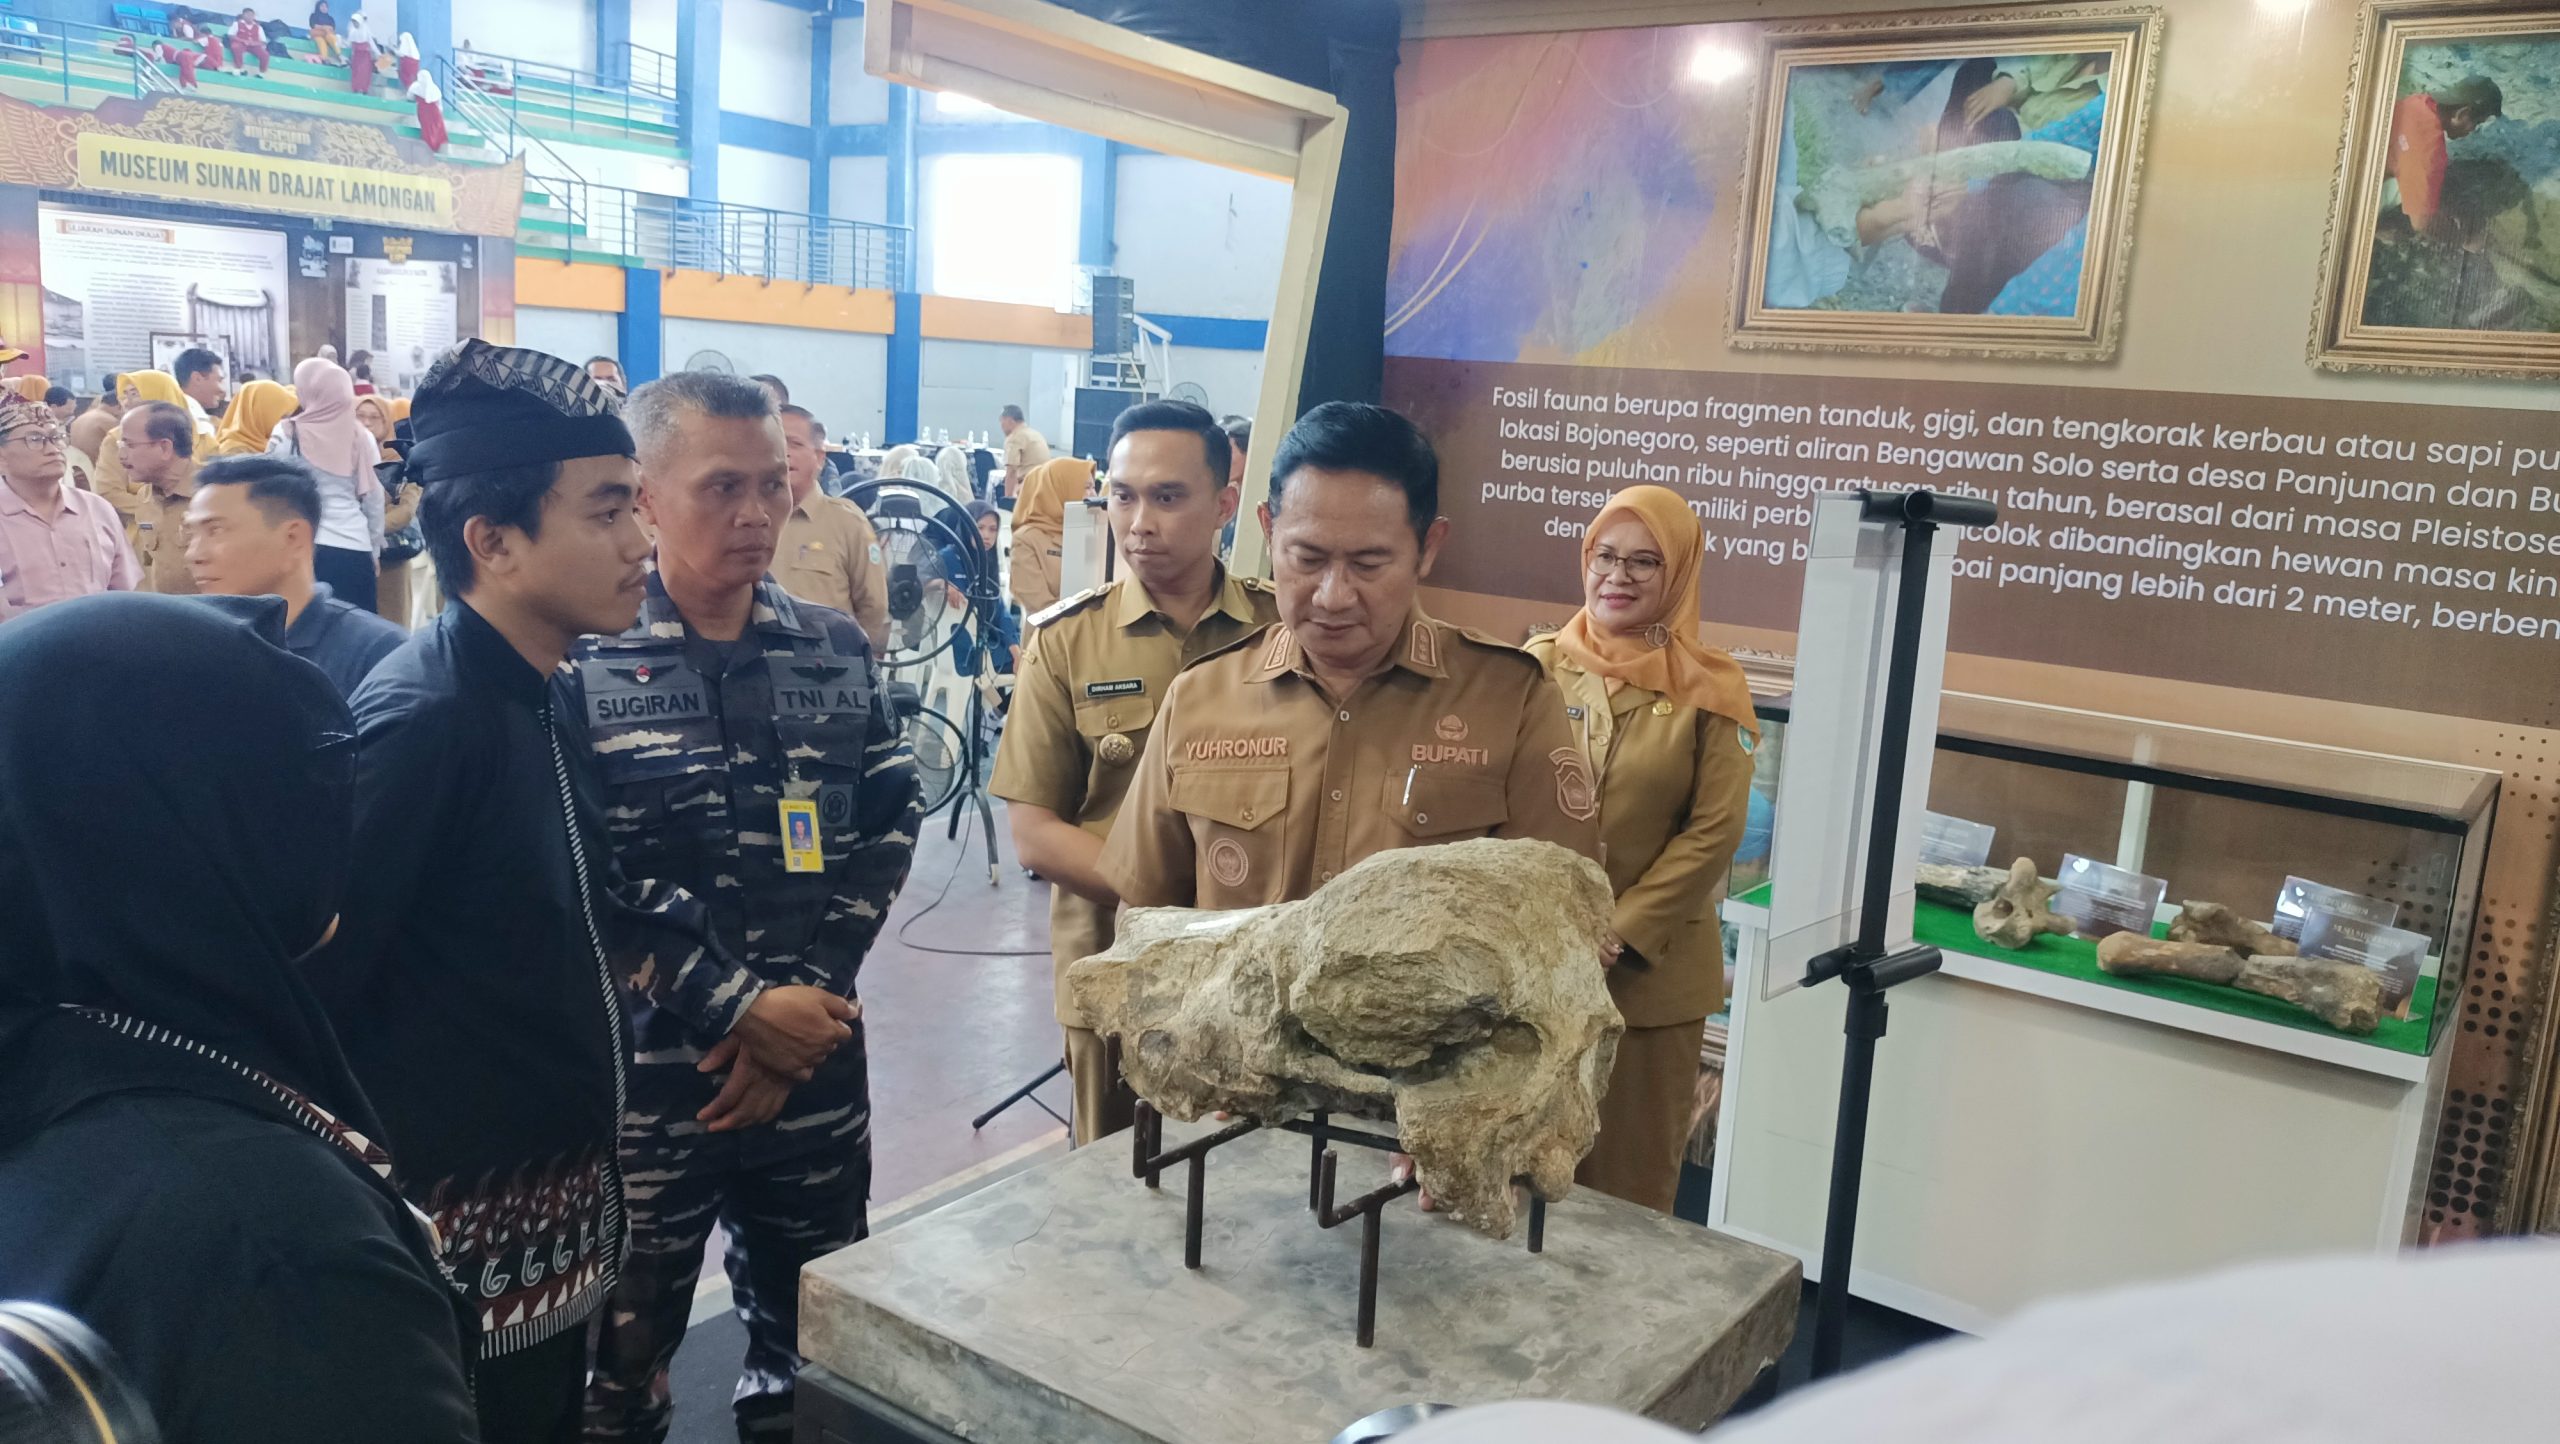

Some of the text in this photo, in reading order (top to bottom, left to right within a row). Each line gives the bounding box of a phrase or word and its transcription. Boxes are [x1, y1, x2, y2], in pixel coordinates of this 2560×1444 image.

[100, 150, 436, 213] MUSEUM SUNAN DRAJAT LAMONGAN
[1492, 387, 1538, 409] Fosil
[1544, 388, 1608, 413] fauna
[1614, 392, 1698, 423] berupa
[1705, 396, 1812, 428] fragmen
[1819, 404, 1916, 433] tanduk,
[1923, 408, 1980, 440] gigi,
[1987, 412, 2044, 437] dan
[2053, 416, 2205, 449] tengkorak
[2212, 424, 2326, 455] kerbau
[2335, 434, 2416, 461] atau
[2426, 440, 2503, 474] sapi
[1500, 418, 1560, 441] lokasi
[1565, 423, 1699, 455] Bojonegoro,
[1706, 435, 1790, 460] seperti
[1795, 437, 1869, 463] aliran
[1876, 441, 2024, 474] Bengawan
[2032, 451, 2093, 477] Solo
[2101, 459, 2179, 484] serta
[2187, 462, 2266, 491] desa
[2275, 468, 2436, 504] Panjunan
[2447, 480, 2518, 510] dan
[1481, 481, 1545, 503] purba
[1551, 485, 1614, 509] terse
[1959, 521, 2043, 548] colok
[2049, 526, 2261, 570] dibandingkan
[2271, 545, 2383, 580] hewan
[2394, 562, 2496, 591] masa
[1501, 449, 1580, 475] berusia
[1586, 458, 1680, 482] puluhan
[1686, 462, 1732, 487] ribu
[1739, 466, 1827, 499] hingga
[2007, 486, 2097, 519] tahun,
[2106, 492, 2222, 526] berasal
[2231, 504, 2295, 532] dari
[2304, 513, 2401, 541] masa
[2411, 519, 2560, 556] Pleistose
[1544, 516, 1587, 539] den
[1723, 536, 1785, 565] yang
[1999, 562, 2123, 600] panjang
[2131, 570, 2205, 601] lebih
[2213, 580, 2277, 609] dari
[2284, 586, 2304, 612] 2
[2313, 593, 2421, 629] meter,
[597, 693, 699, 719] SUGIRAN
[780, 689, 867, 710] TNI AL
[1185, 736, 1288, 761] YUHRONUR
[1411, 743, 1489, 766] BUPATI
